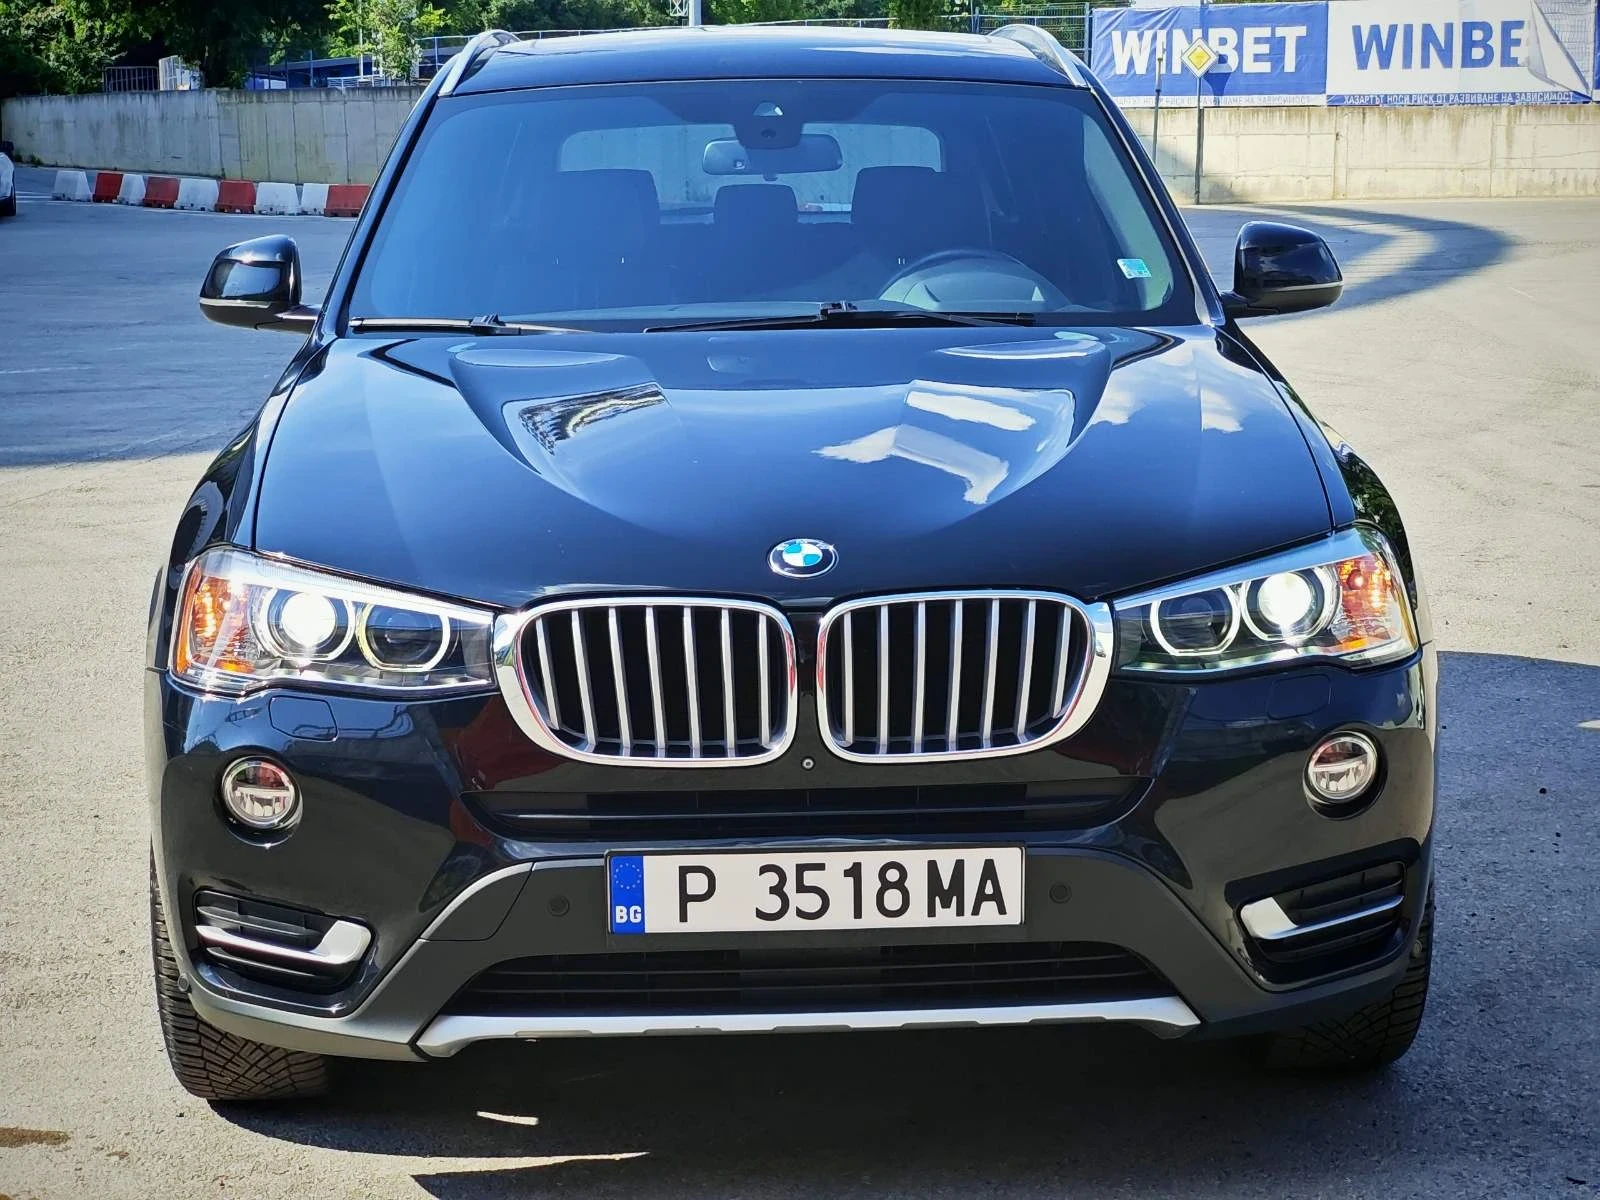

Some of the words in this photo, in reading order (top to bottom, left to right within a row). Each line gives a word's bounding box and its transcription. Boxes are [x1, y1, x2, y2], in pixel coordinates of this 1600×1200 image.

[1111, 26, 1307, 75] WINBET
[1351, 20, 1526, 70] WINBE
[1387, 95, 1410, 105] НОСИ
[1411, 94, 1434, 105] РИСК
[1436, 94, 1447, 104] ОТ
[1449, 93, 1499, 104] РАЗВИВАНЕ
[1501, 93, 1514, 103] НА
[1515, 91, 1574, 103] ЗАВИСИМОСТ
[615, 904, 642, 924] BG
[678, 865, 717, 923] P
[755, 860, 911, 921] 3518
[926, 858, 1008, 918] MA
